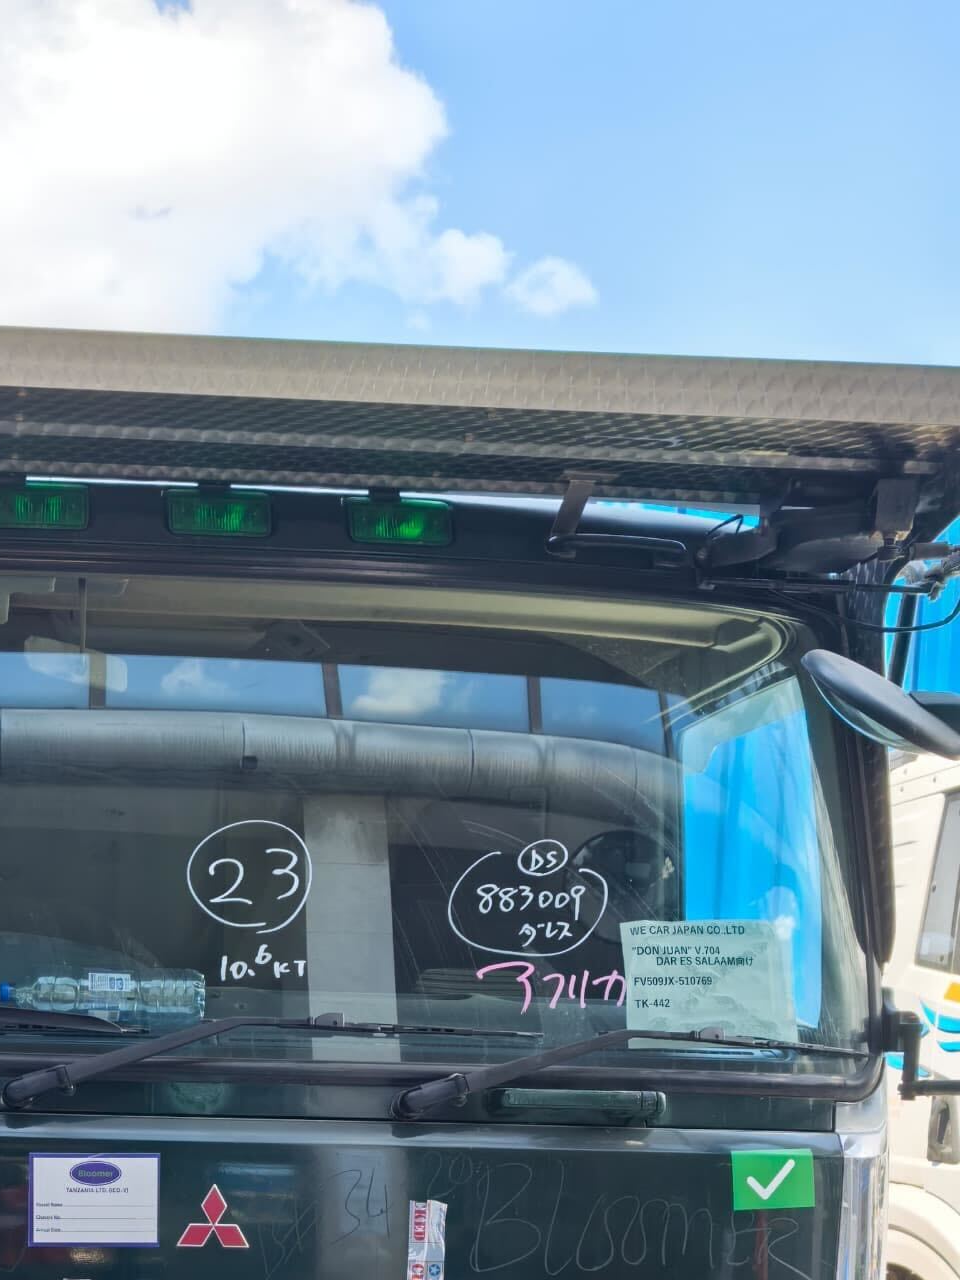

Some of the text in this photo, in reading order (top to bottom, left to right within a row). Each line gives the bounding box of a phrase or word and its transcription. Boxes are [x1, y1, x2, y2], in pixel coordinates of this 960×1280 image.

[208, 847, 300, 905] 23
[630, 925, 646, 935] WE
[649, 925, 670, 935] CAR
[672, 925, 704, 935] JAPAN
[694, 946, 721, 956] V.704
[656, 956, 678, 966] DAR
[680, 956, 693, 966] ES
[635, 999, 671, 1009] TK-442
